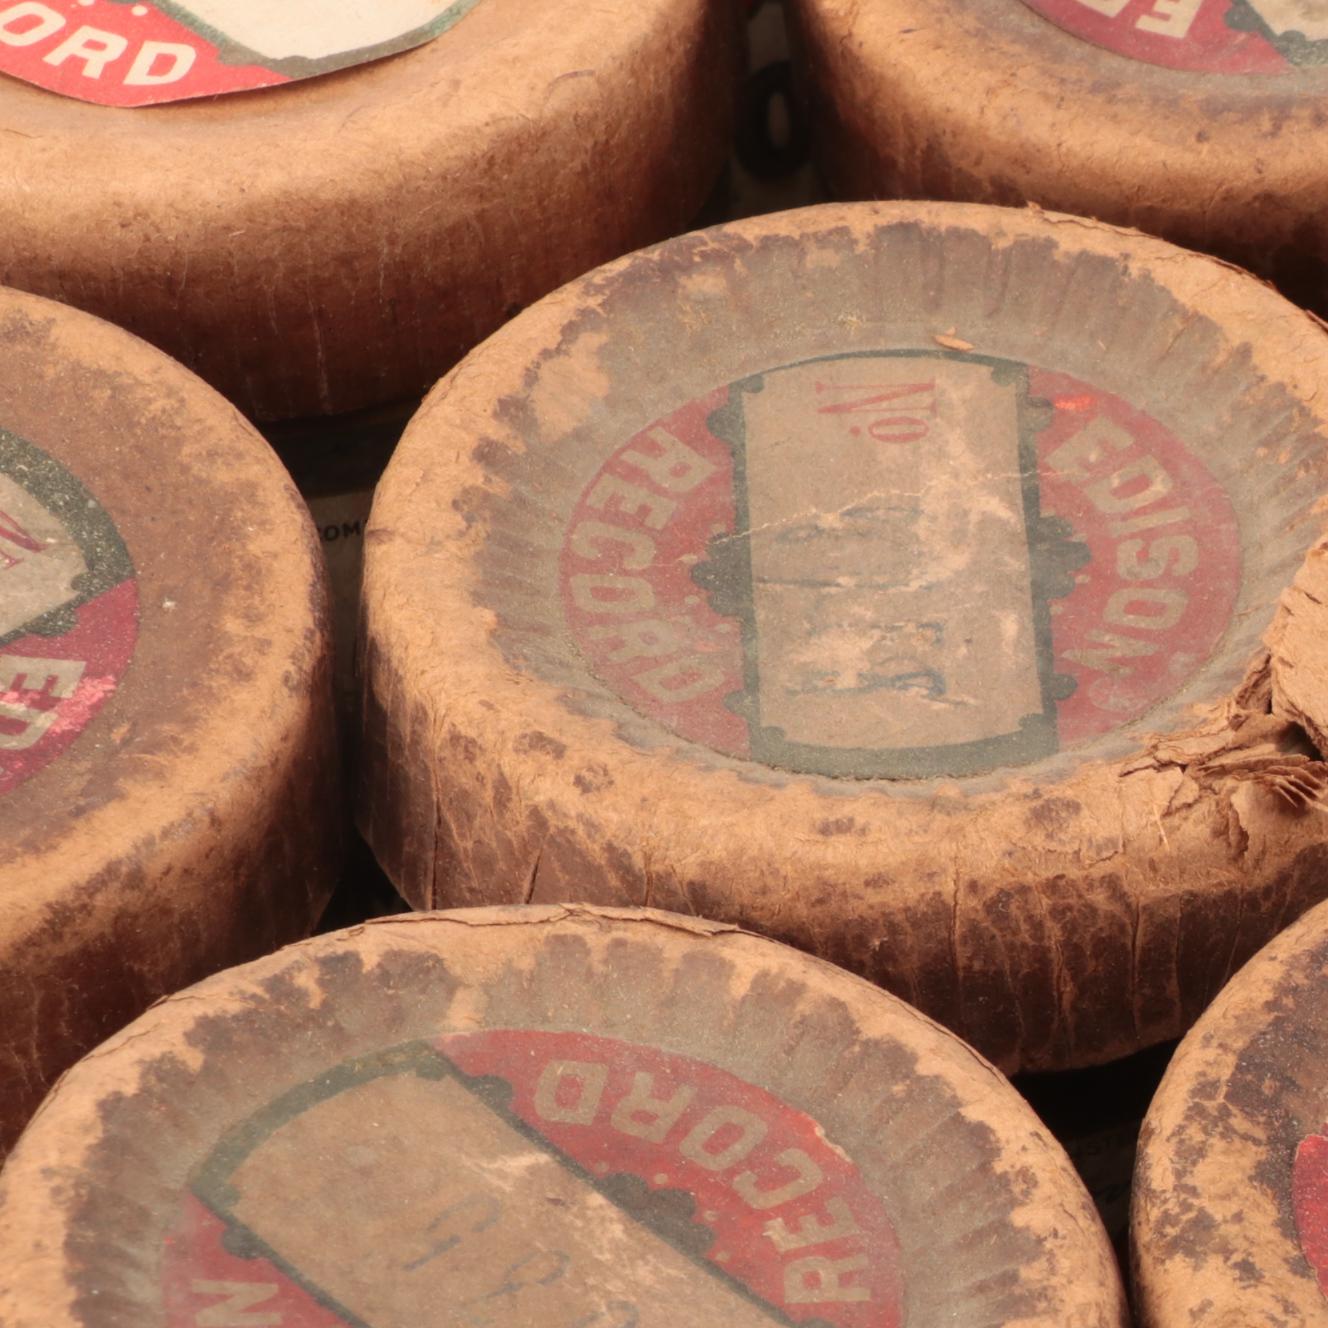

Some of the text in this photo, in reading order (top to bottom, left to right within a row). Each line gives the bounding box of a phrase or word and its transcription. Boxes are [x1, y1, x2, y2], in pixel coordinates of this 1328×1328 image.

[566, 422, 728, 706] RECORD
[1047, 418, 1200, 681] EDISON
[533, 1057, 872, 1304] RECORD
